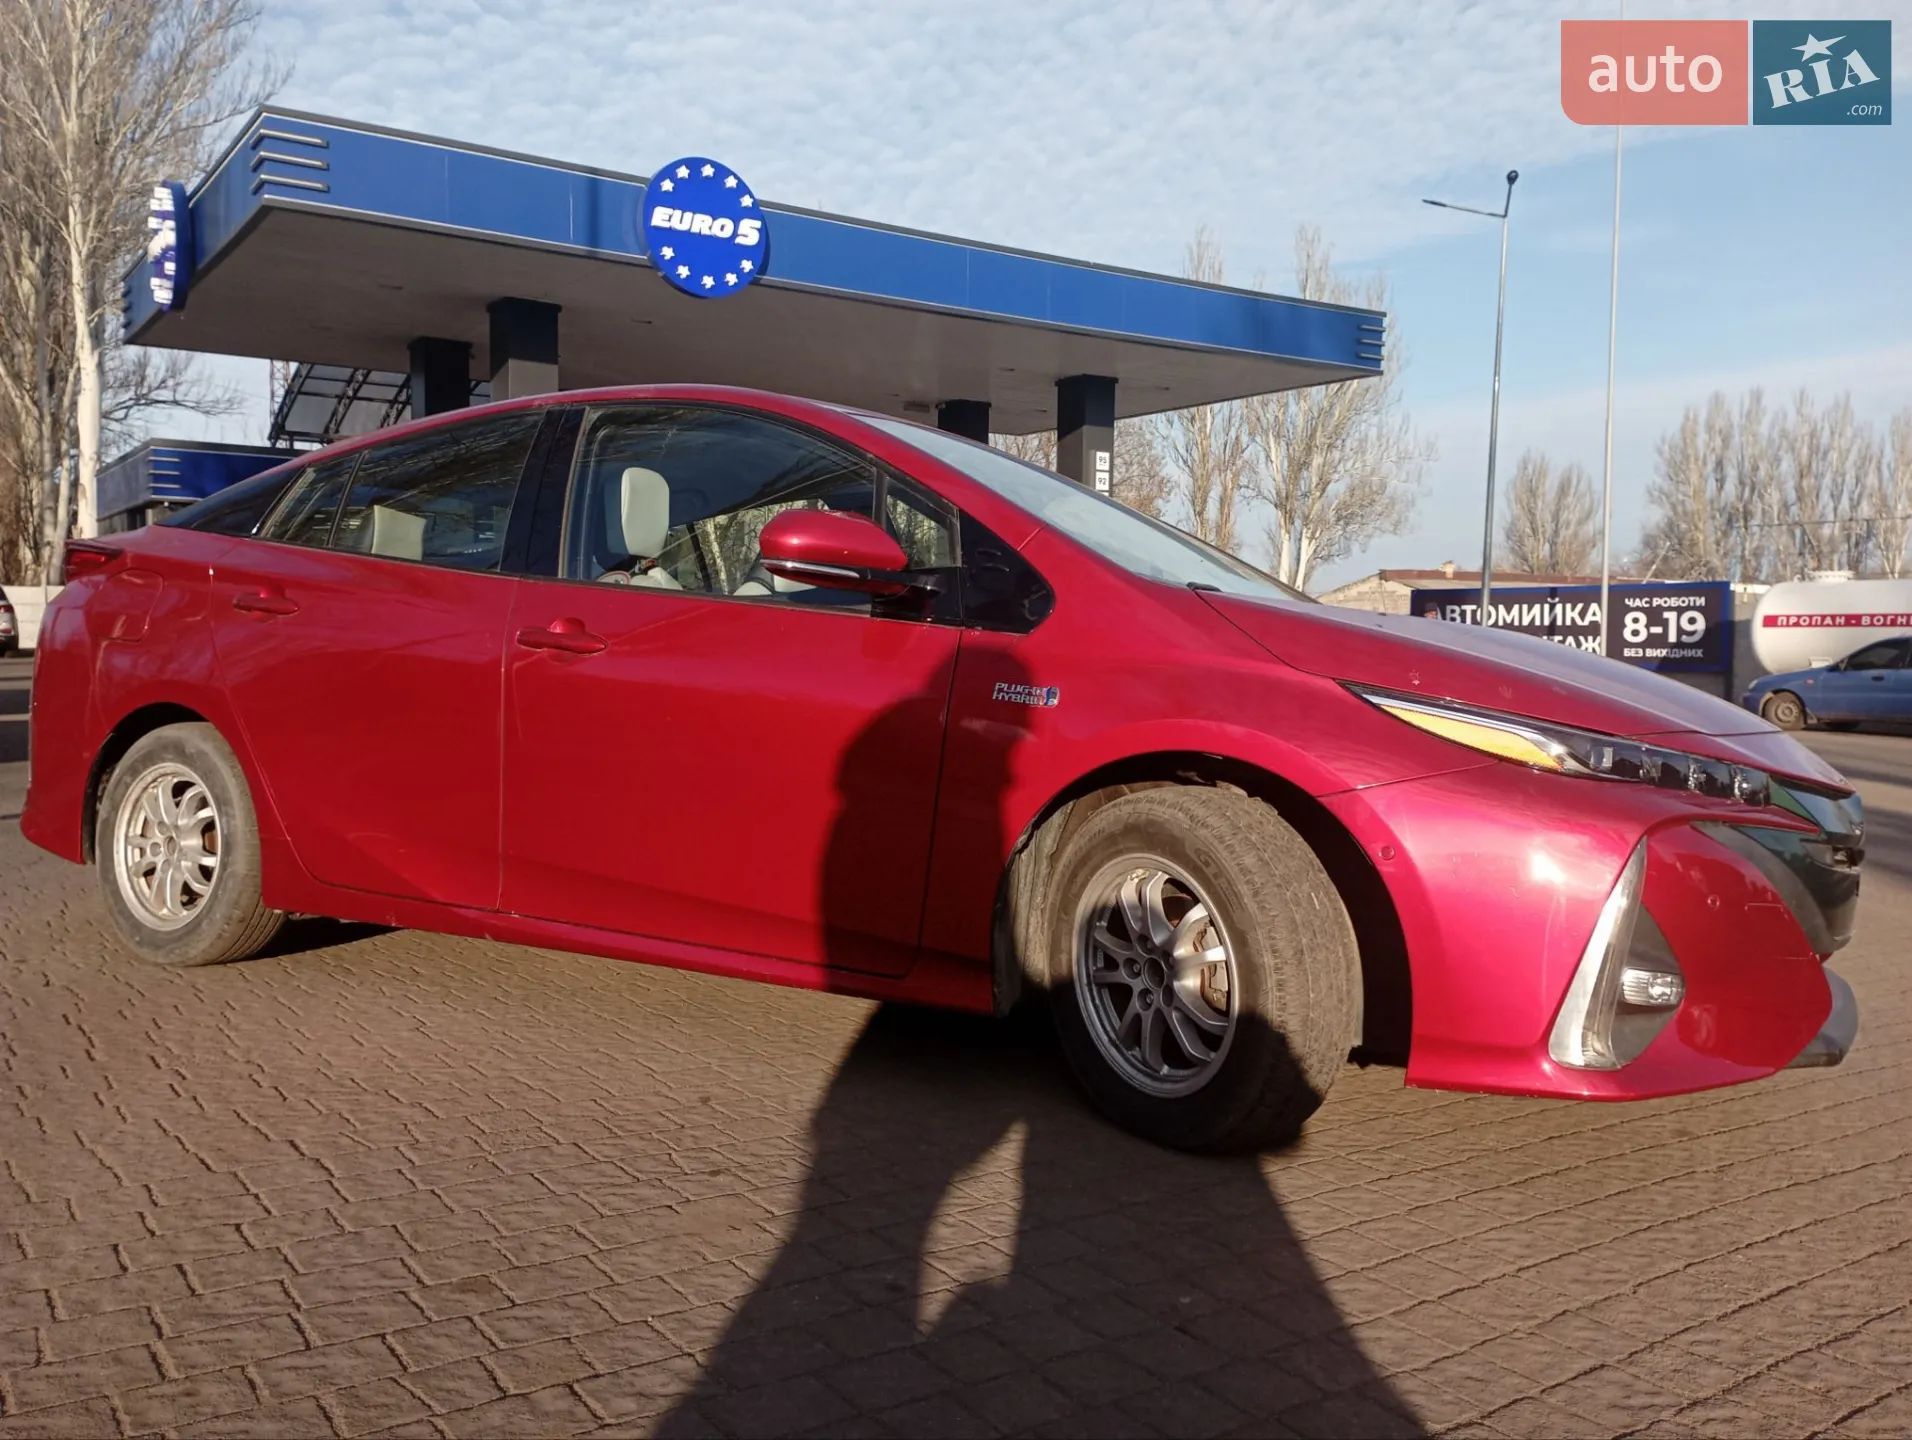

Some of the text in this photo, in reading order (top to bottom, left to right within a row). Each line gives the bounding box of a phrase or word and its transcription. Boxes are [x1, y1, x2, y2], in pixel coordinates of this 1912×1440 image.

[651, 206, 762, 246] EURO 5
[1098, 477, 1107, 486] 92
[1624, 596, 1706, 608] ЧАС РОБОТИ
[1623, 610, 1707, 643] 8-19
[1777, 615, 1846, 627] ПРОПАН
[1623, 647, 1704, 658] БЕЗ ВИХІДНИХ
